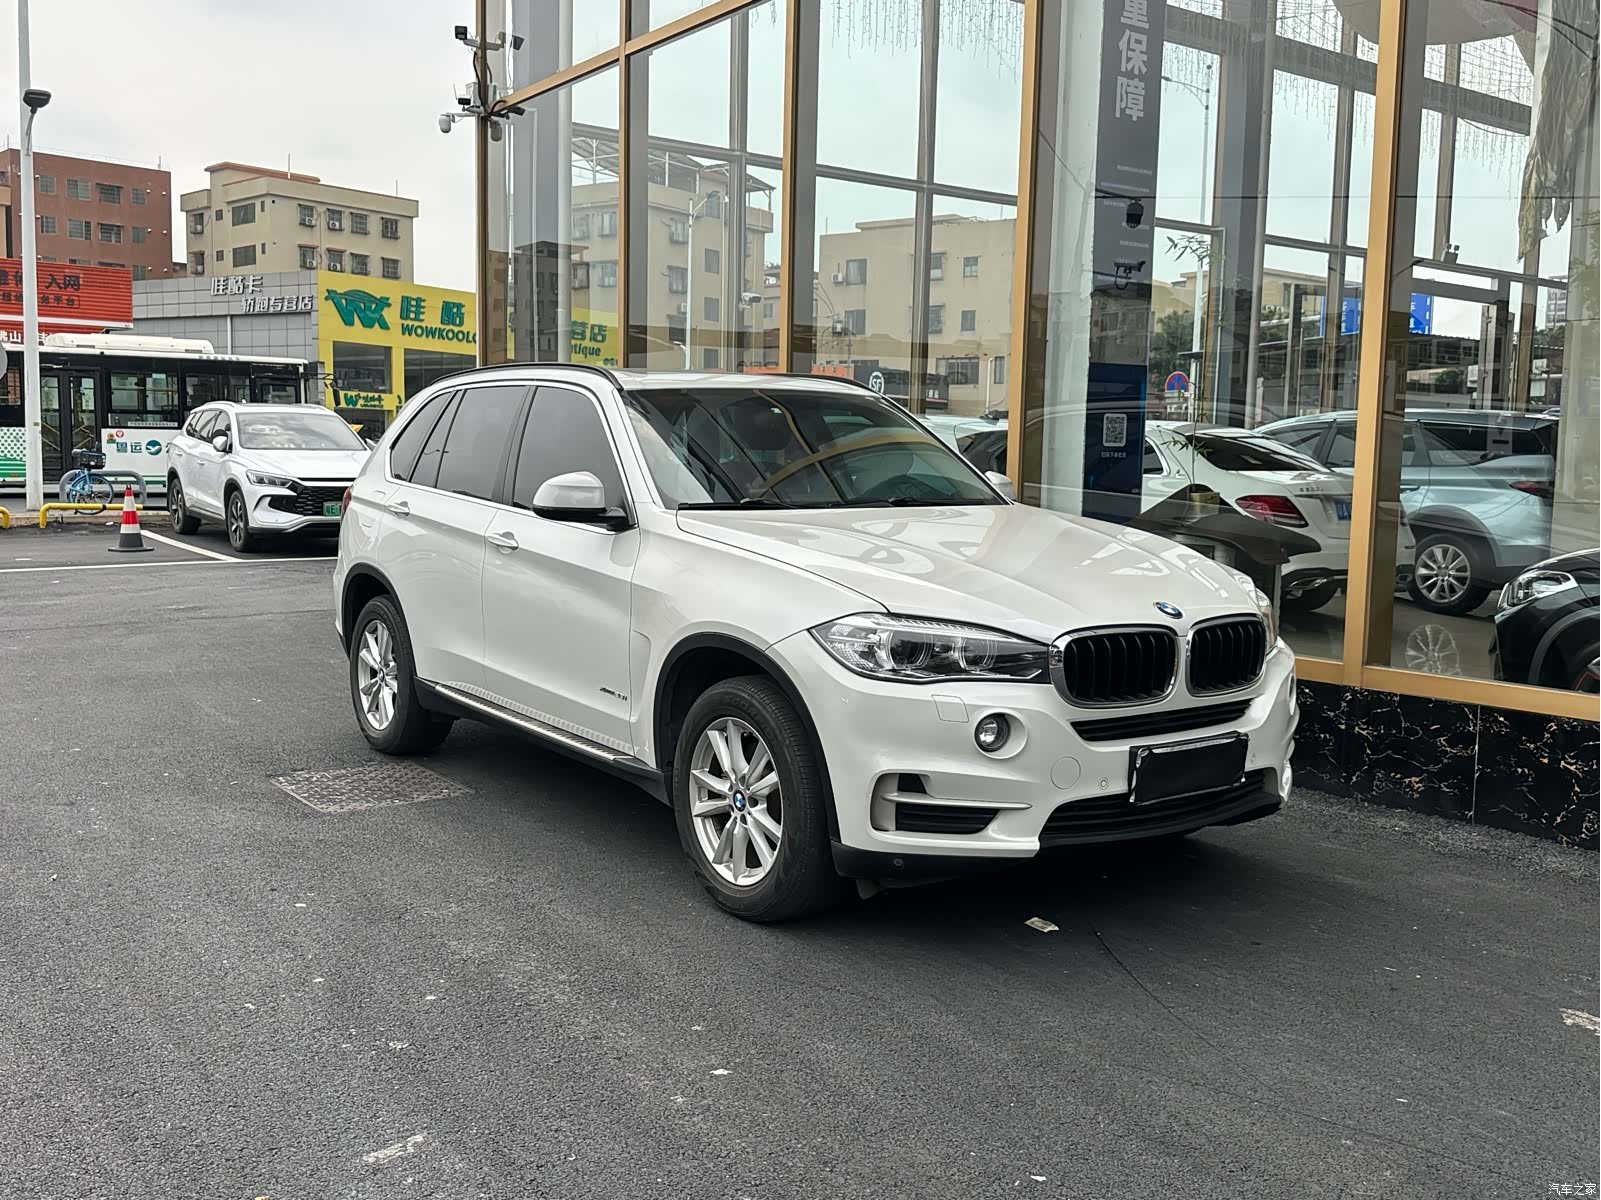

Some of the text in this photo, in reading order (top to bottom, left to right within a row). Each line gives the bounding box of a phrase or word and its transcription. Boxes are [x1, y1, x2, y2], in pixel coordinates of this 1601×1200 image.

[211, 275, 262, 295] 哇酷卡
[242, 295, 313, 313] 轿跑专营店
